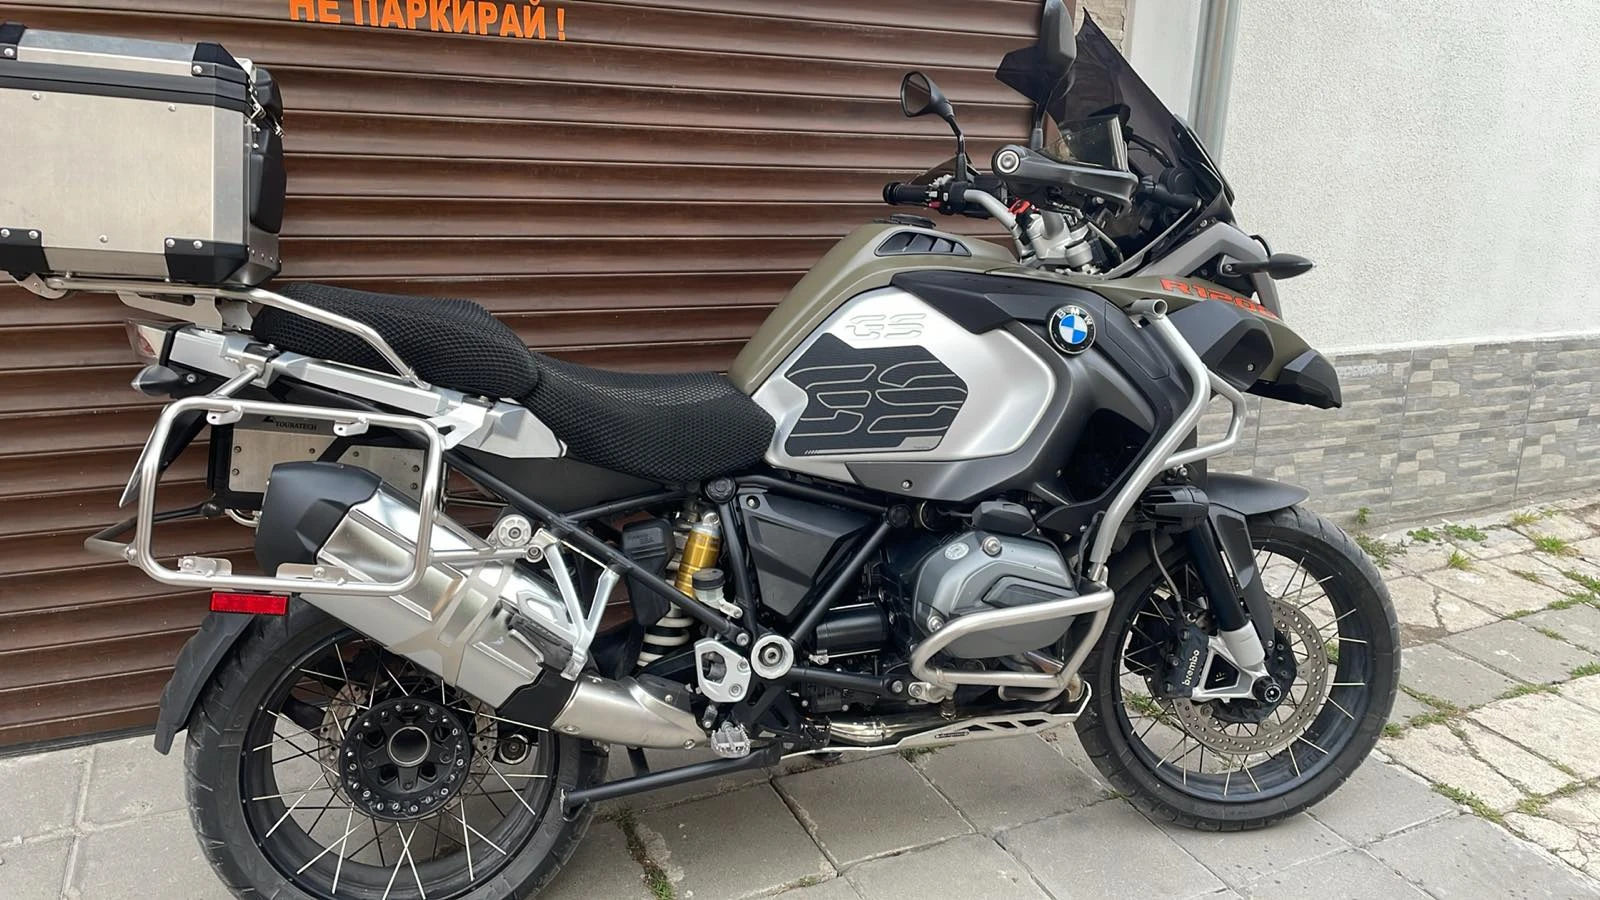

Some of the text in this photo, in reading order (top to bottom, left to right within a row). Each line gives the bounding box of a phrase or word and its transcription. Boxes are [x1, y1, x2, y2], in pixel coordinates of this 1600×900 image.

[289, 0, 341, 24] НЕ
[351, 0, 546, 40] ПАРКИРАЙ
[845, 312, 928, 341] GS
[1056, 306, 1094, 326] BMW
[275, 420, 318, 431] TOURATECH
[1181, 649, 1201, 686] brembo
